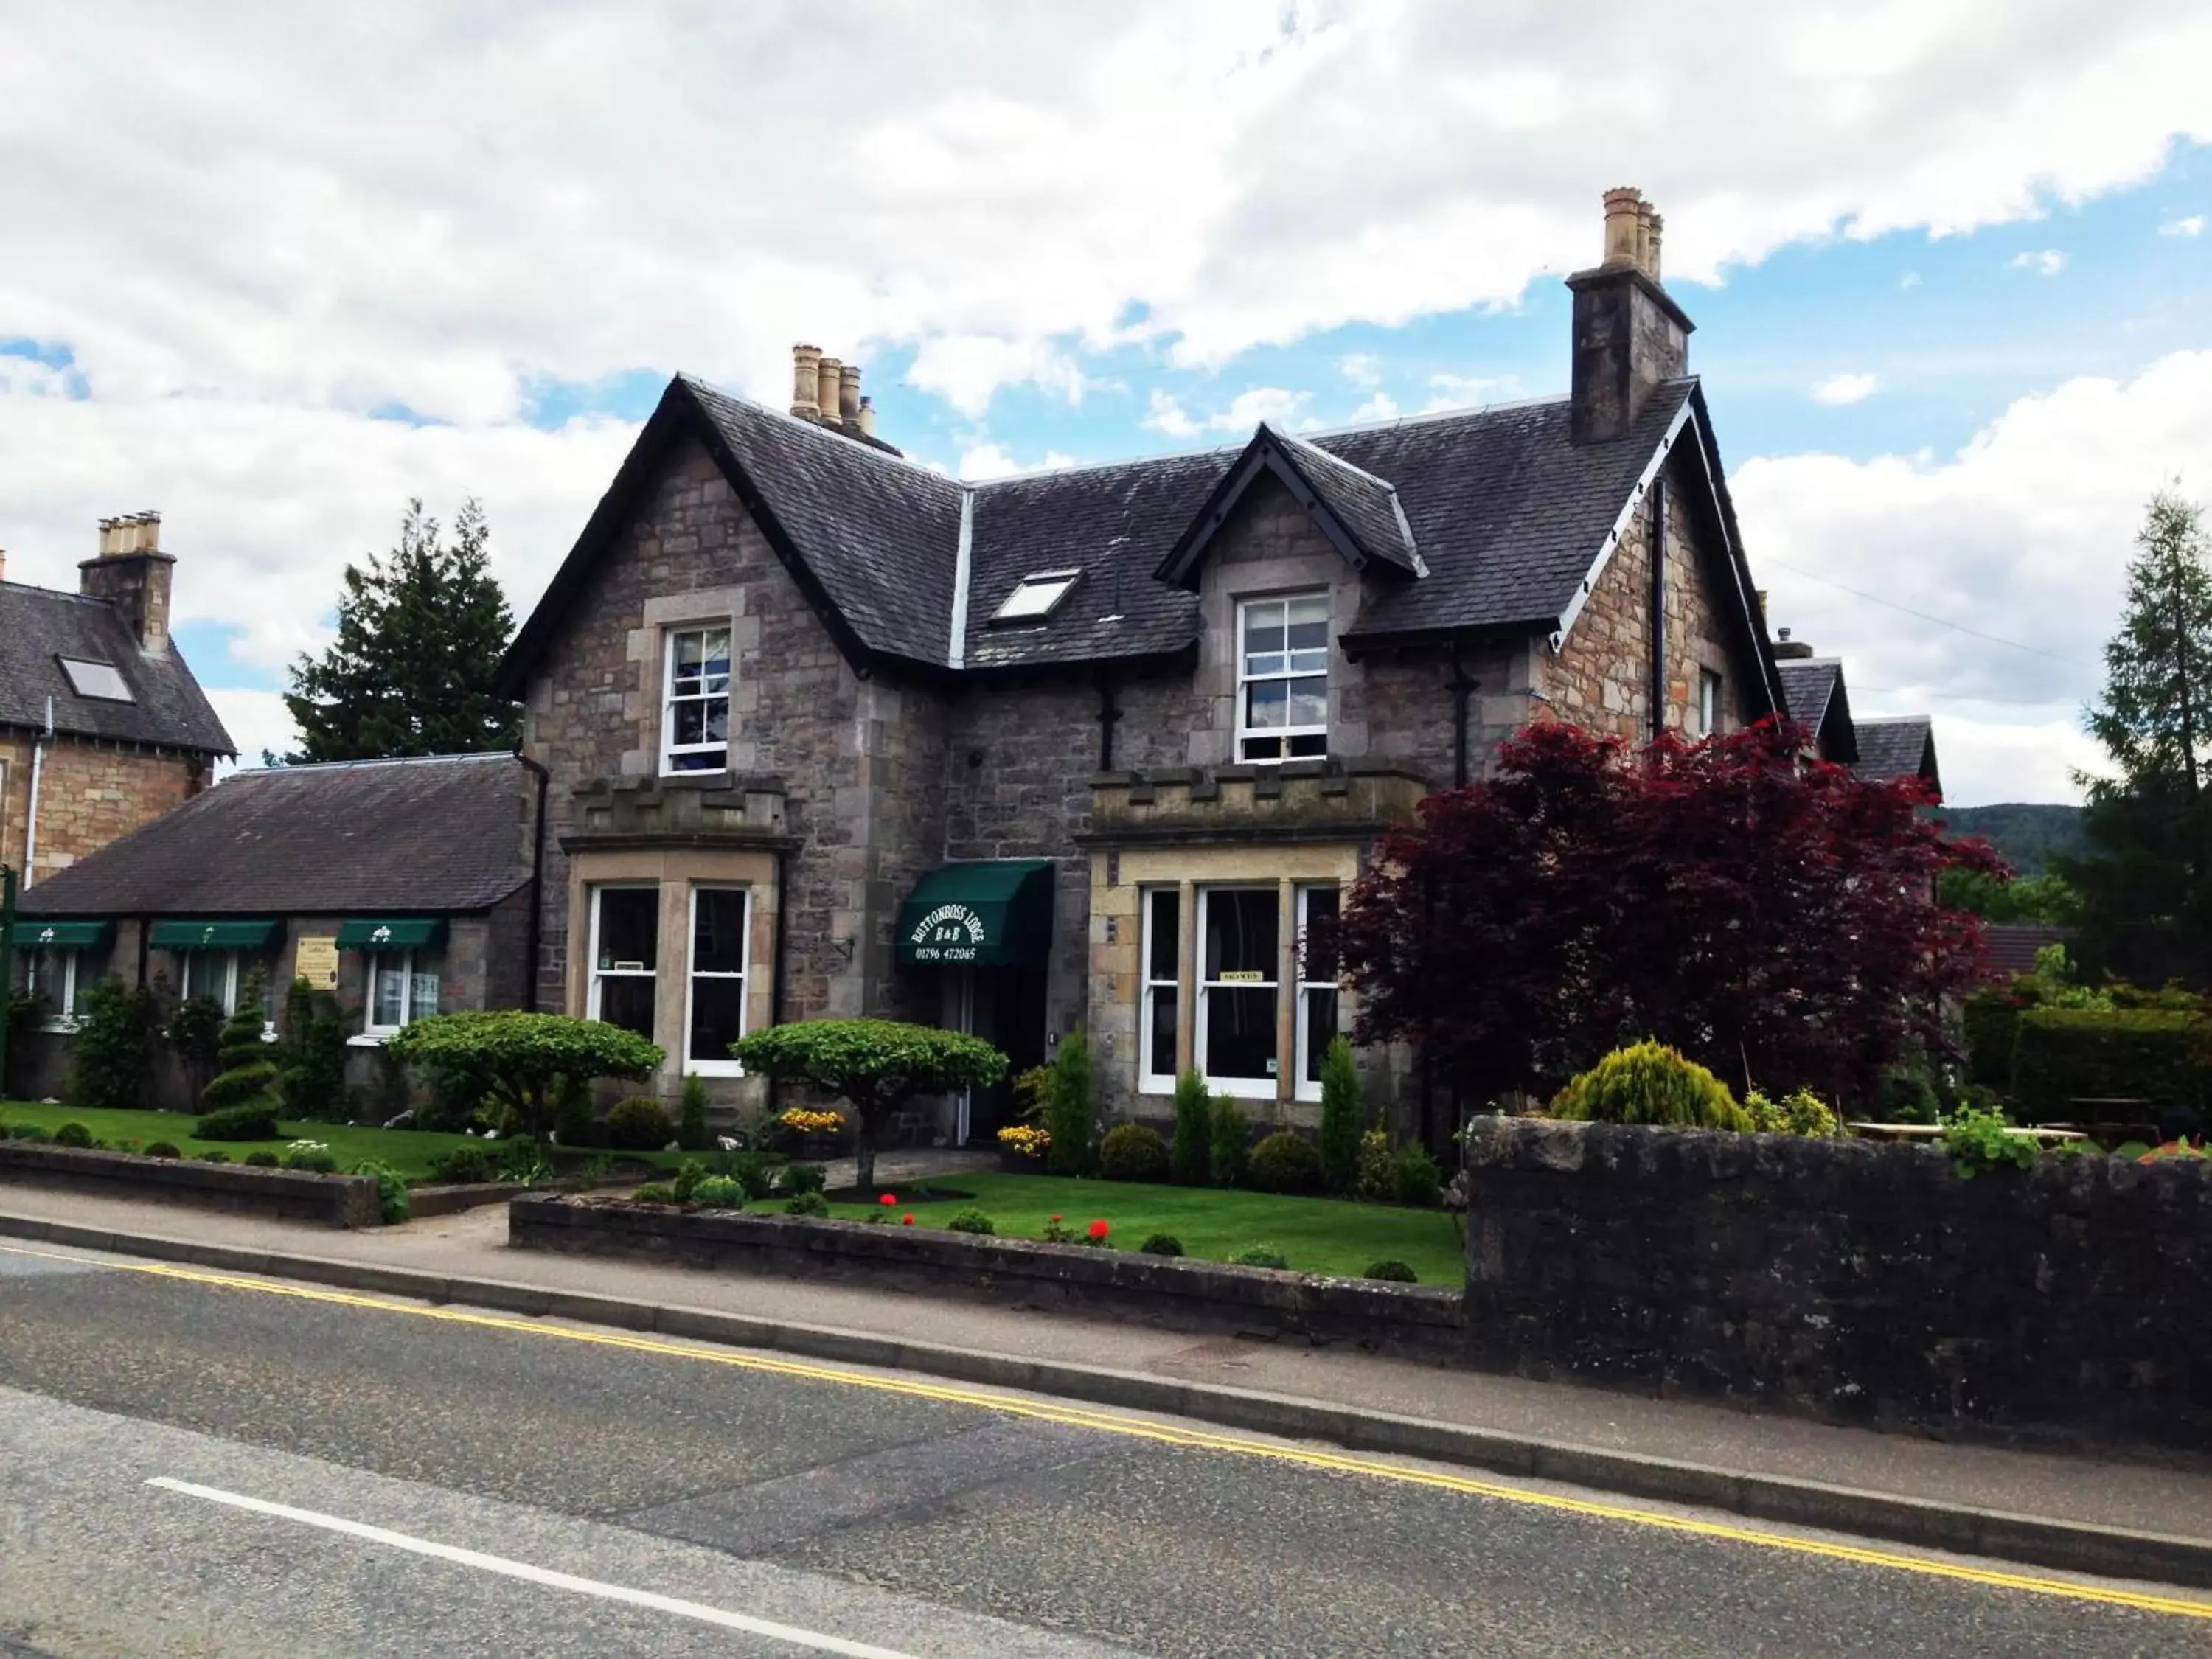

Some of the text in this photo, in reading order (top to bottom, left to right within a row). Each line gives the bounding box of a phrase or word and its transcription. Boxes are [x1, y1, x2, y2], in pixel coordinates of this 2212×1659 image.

[911, 904, 984, 944] BUTTONBOSS LODGE
[915, 947, 976, 959] 01796 472065
